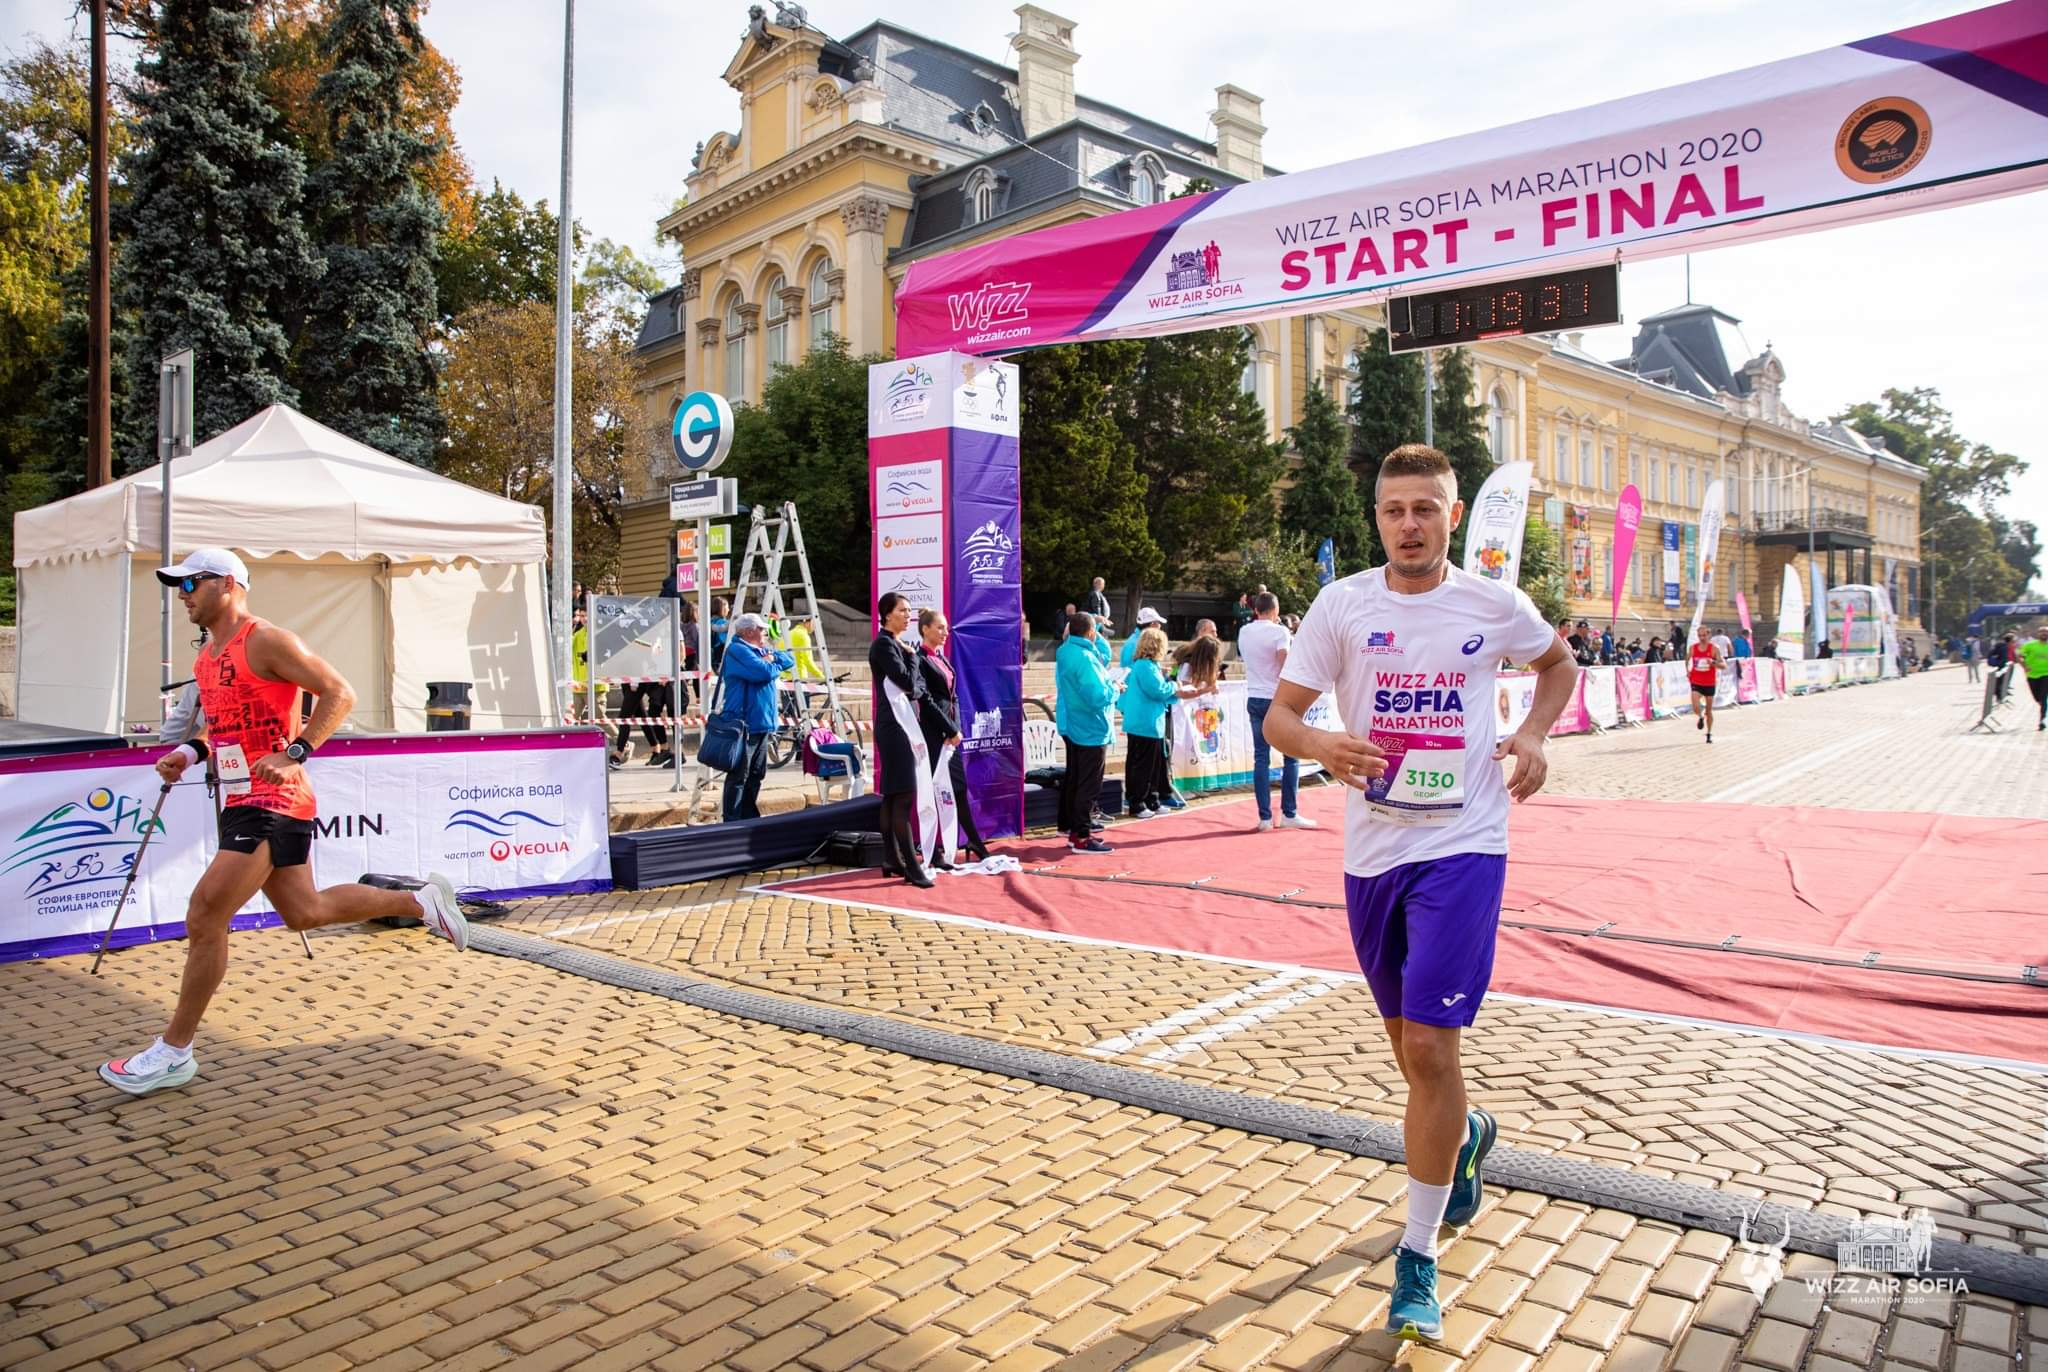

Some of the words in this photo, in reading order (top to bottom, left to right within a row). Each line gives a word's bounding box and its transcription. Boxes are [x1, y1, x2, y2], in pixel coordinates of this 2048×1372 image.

[1862, 153, 1905, 166] ATHLETICS
[1869, 148, 1898, 158] WORLD
[1275, 216, 1340, 247] WIZZ
[1349, 205, 1390, 233] AIR
[1399, 187, 1482, 223] SOFIA
[1490, 146, 1667, 204] MARATHON
[1679, 128, 1763, 167] 2020
[1280, 218, 1469, 291] START
[1541, 164, 1765, 247] FINAL
[1148, 294, 1179, 309] WIZZ
[1182, 290, 1203, 303] AIR
[1206, 283, 1242, 299] SOFIA
[967, 324, 1031, 345] wizzair.com
[680, 539, 693, 551] N2
[711, 533, 724, 546] N1
[894, 536, 938, 546] VIVACOM
[679, 572, 693, 584] N4
[711, 567, 724, 581] N3
[1376, 671, 1427, 689] WIZZ
[1432, 671, 1467, 688] AIR
[1374, 690, 1464, 713] SOFIA
[1372, 715, 1464, 729] MARATHON
[962, 740, 979, 750] WIZZ
[992, 738, 1013, 747] SOFIA
[1405, 768, 1455, 788] 3130
[448, 785, 525, 802] Софийска
[529, 784, 563, 798] вода
[444, 852, 468, 861] част
[470, 850, 485, 859] от
[513, 841, 570, 856] VEOLIA
[37, 888, 137, 906] СОФИЯ-ЕВРОПЕЙСА
[37, 902, 84, 916] СТОЛИЦА
[85, 902, 98, 910] НА
[101, 898, 137, 909] СПОТА
